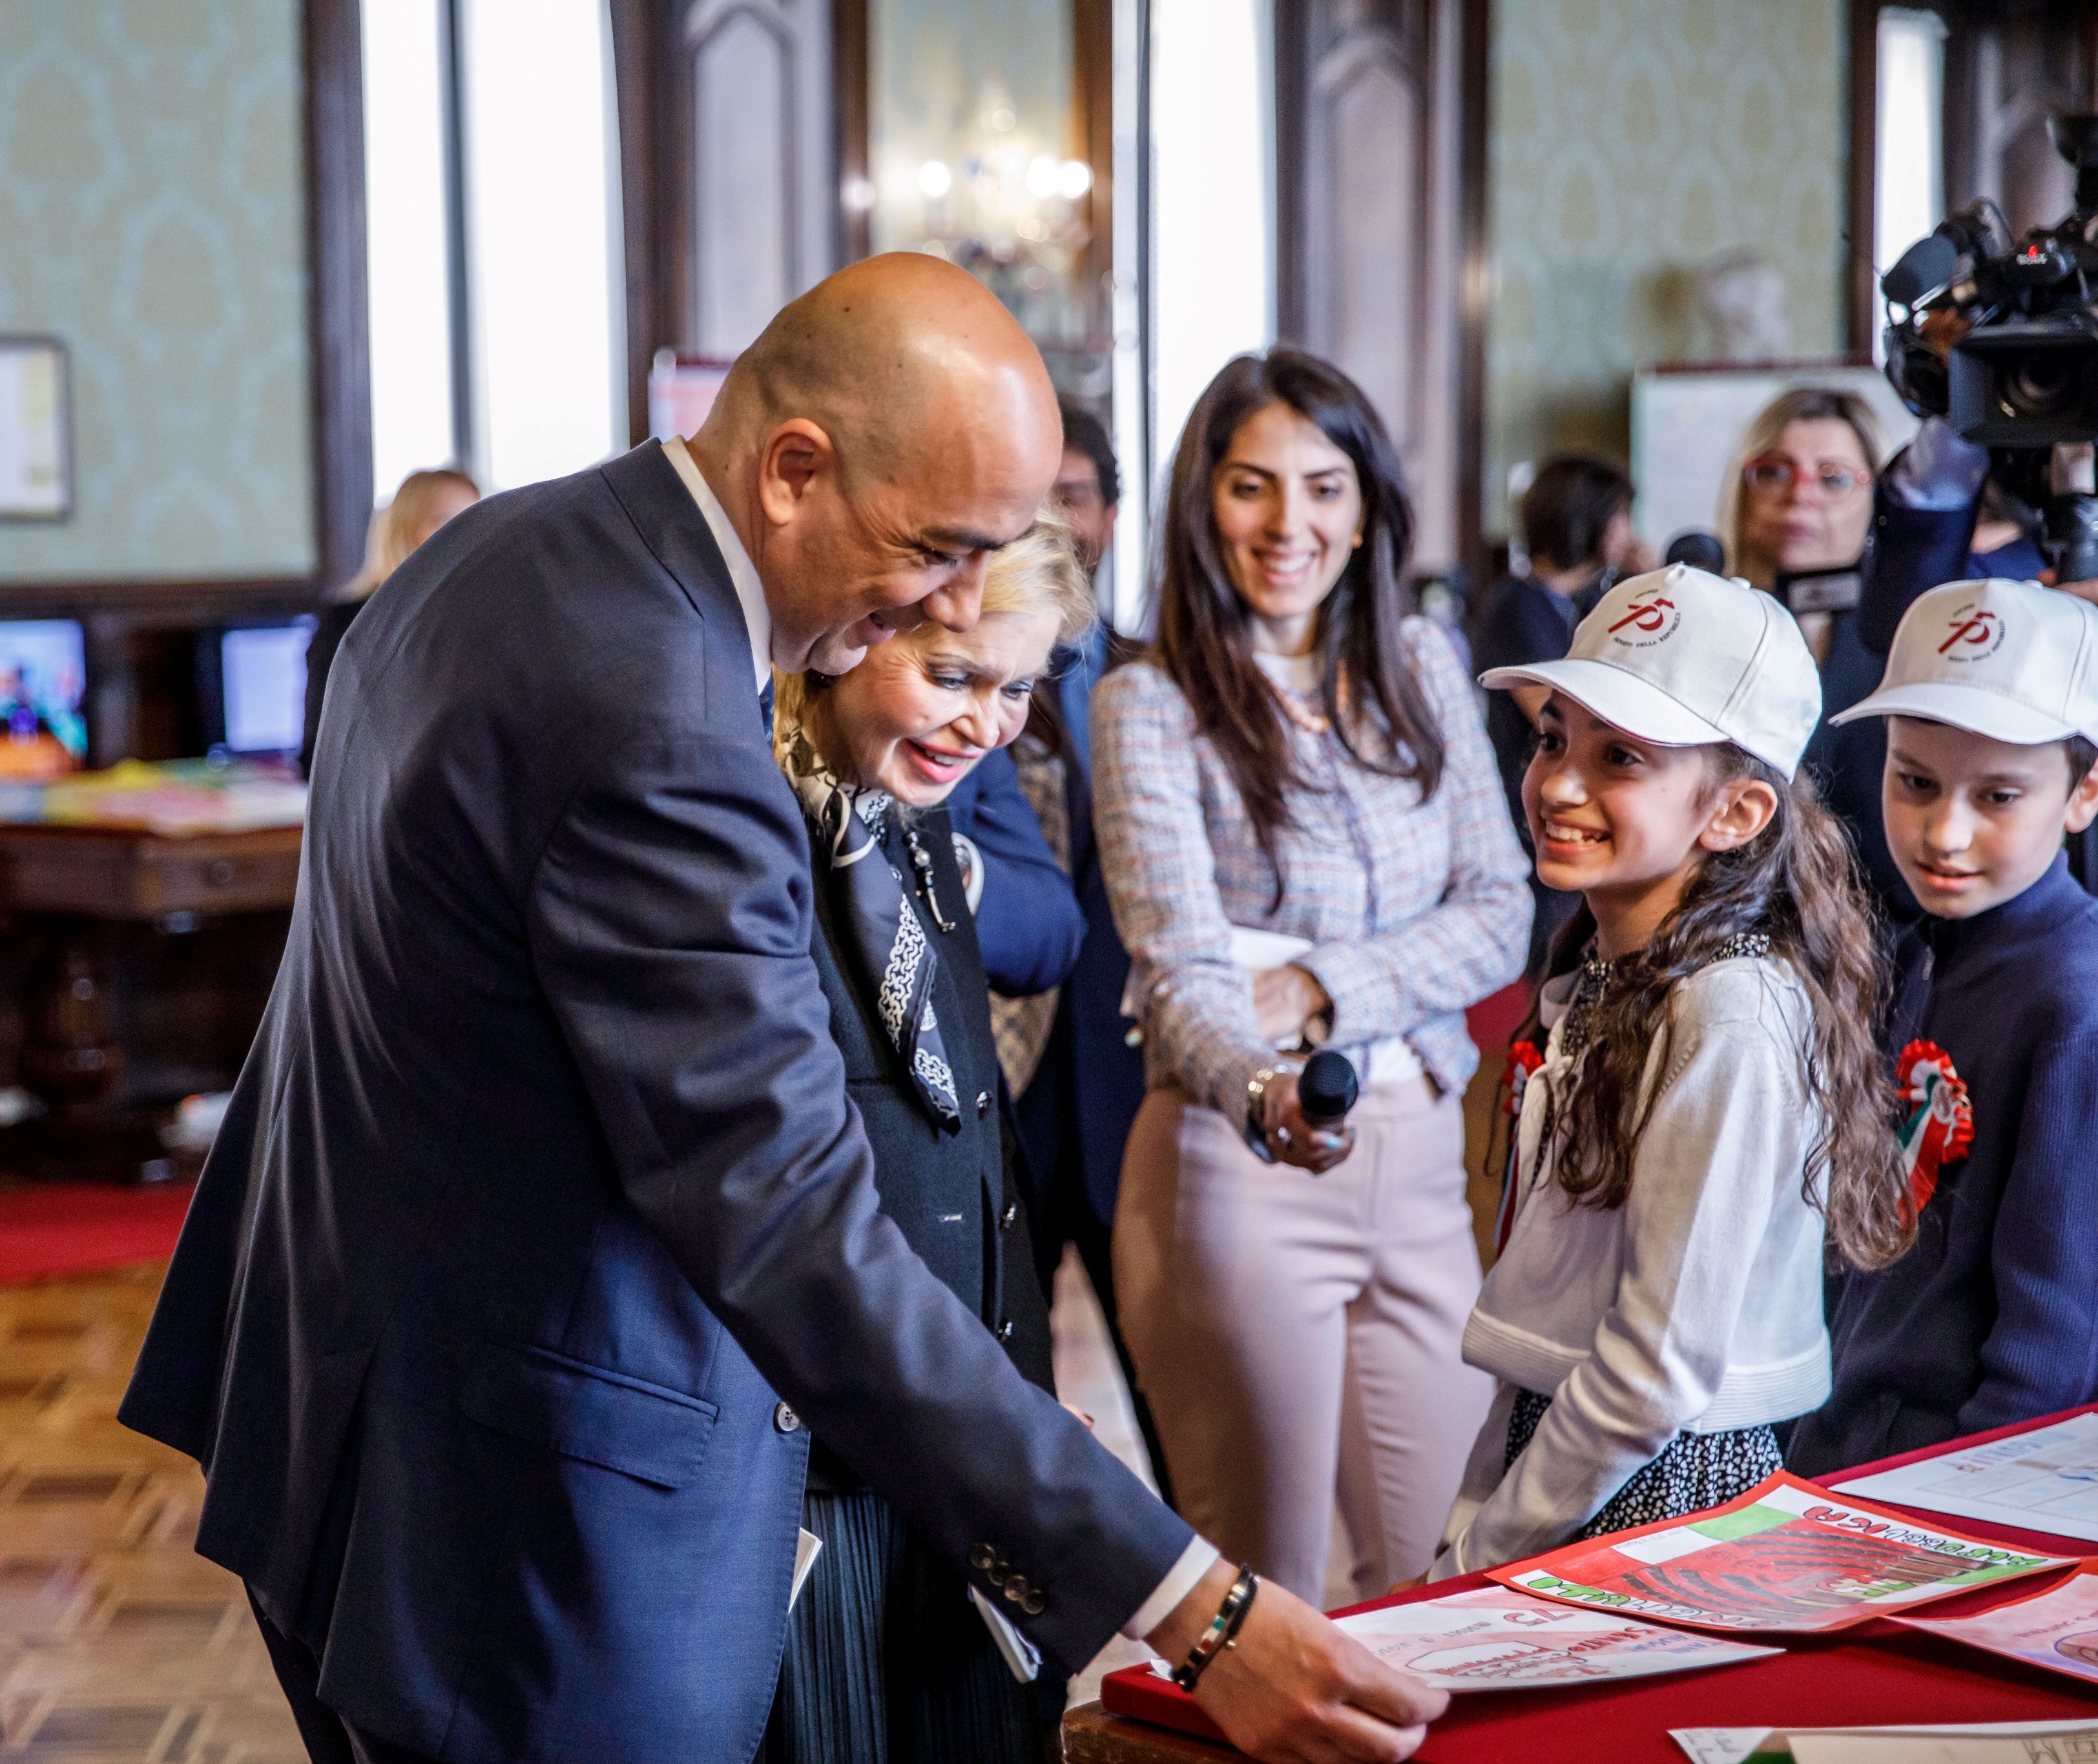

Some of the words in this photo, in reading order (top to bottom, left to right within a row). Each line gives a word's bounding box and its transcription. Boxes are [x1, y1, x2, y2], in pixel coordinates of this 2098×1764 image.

[1803, 1506, 2048, 1566] REPUBBLICA
[1502, 1608, 1575, 1628] 75
[1526, 1576, 1781, 1628] ITALIANA
[1568, 1626, 1657, 1655] SENATO
